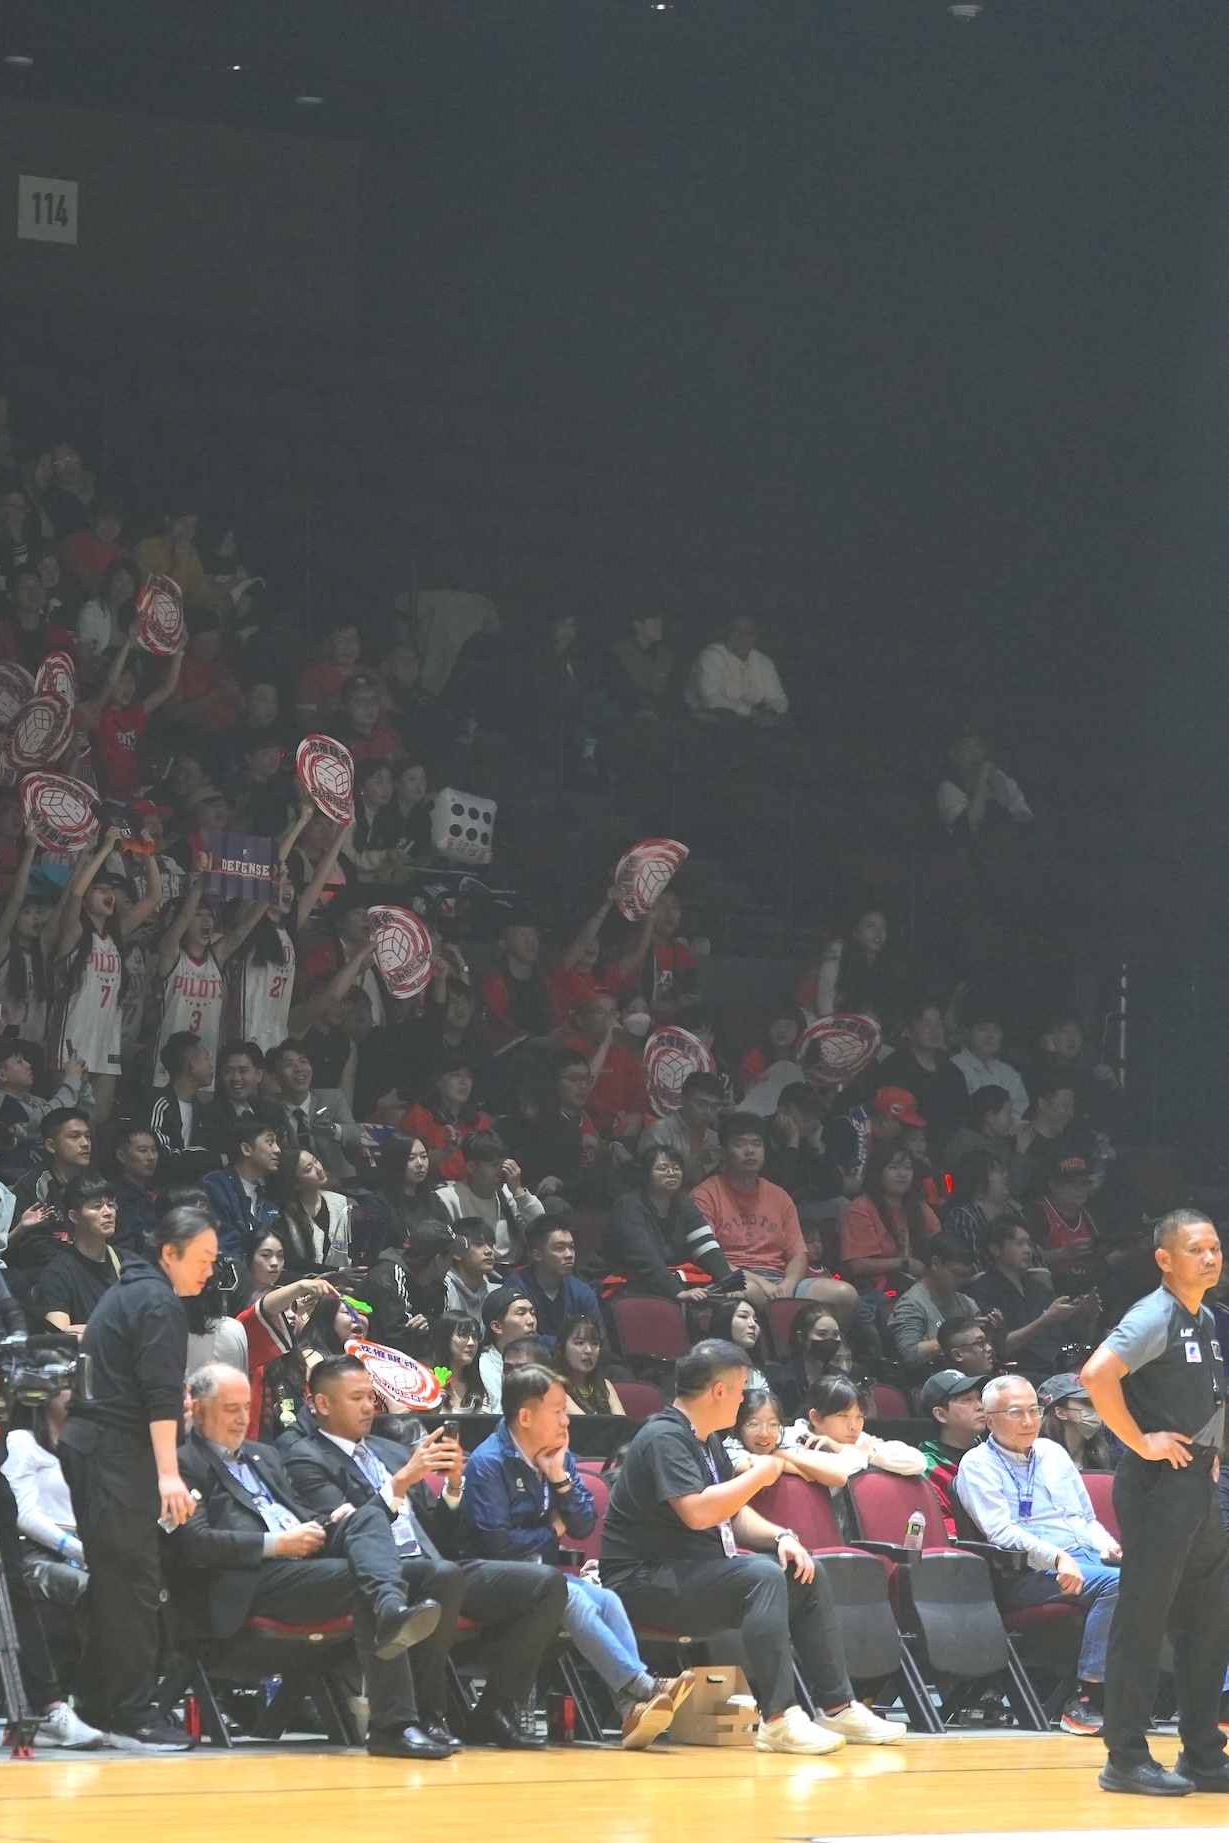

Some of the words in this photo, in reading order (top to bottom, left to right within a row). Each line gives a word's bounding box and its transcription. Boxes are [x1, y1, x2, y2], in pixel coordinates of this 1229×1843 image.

[32, 192, 68, 227] 114
[221, 858, 270, 876] DEFENSE
[100, 985, 111, 1008] 7
[189, 1010, 203, 1032] 3
